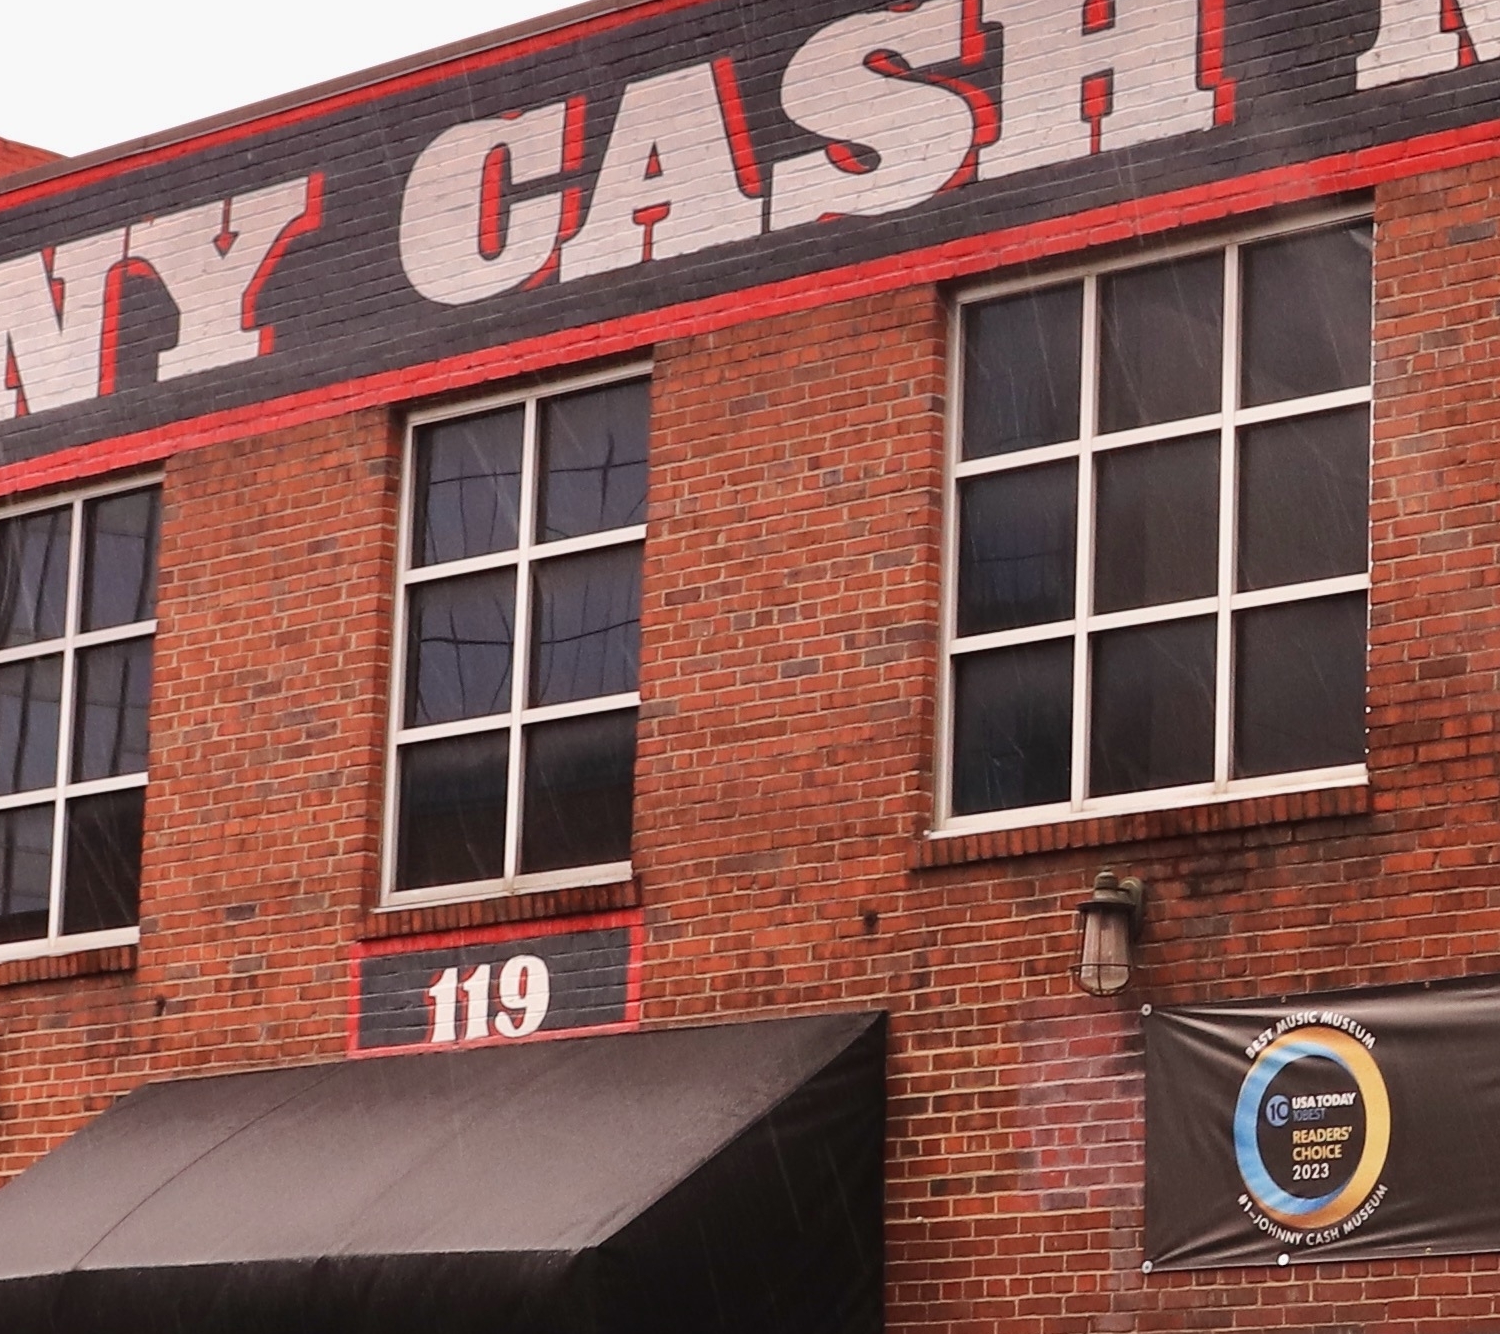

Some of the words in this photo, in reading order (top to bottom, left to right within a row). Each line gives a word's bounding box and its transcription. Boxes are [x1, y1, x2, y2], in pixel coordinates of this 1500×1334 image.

[427, 953, 551, 1044] 119
[1244, 1029, 1274, 1060] BEST
[1275, 1010, 1318, 1035] MUSIC
[1319, 1010, 1377, 1050] MUSEUM
[1292, 1144, 1343, 1162] CHOICE
[1292, 1162, 1330, 1181] 2023
[1305, 1227, 1341, 1247] CASH
[1343, 1183, 1389, 1236] MUSEUM
